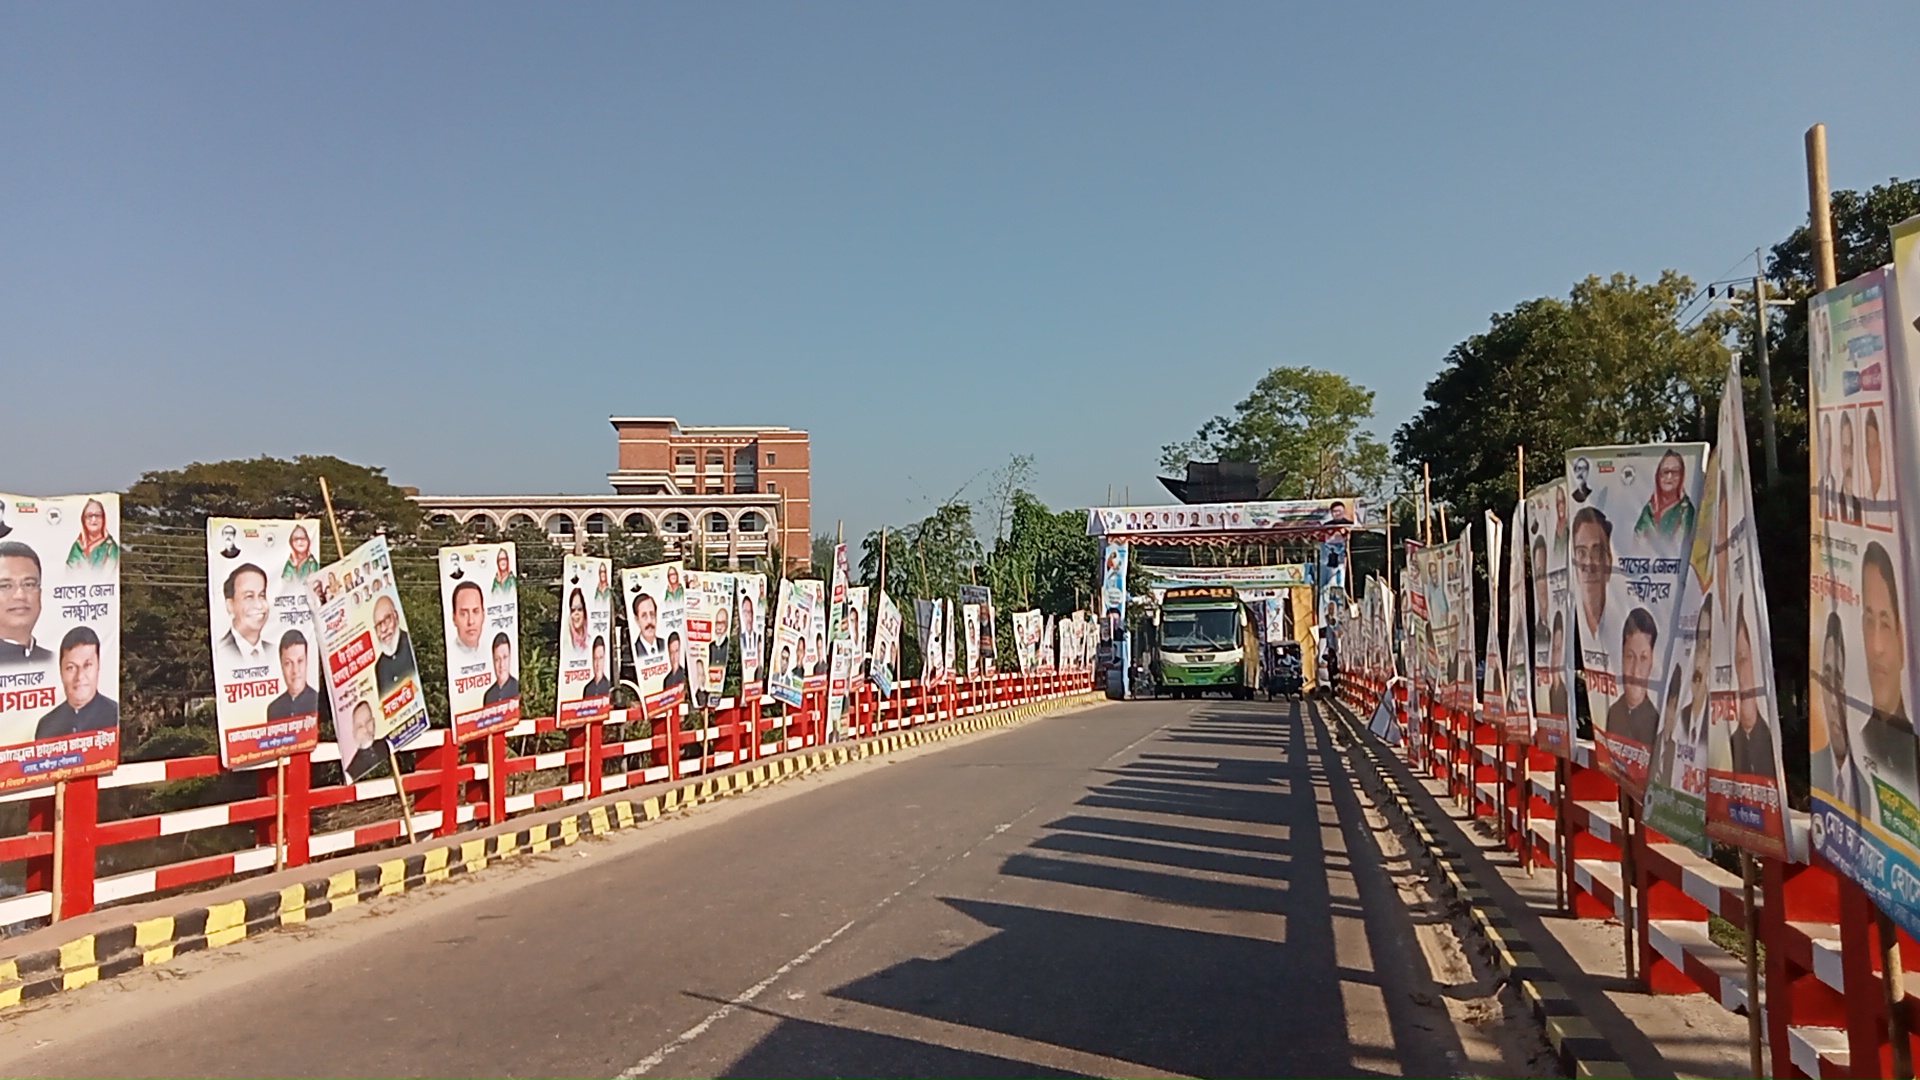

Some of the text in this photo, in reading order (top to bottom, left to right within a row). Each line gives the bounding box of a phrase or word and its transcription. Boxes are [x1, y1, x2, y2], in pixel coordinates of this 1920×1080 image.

[1653, 558, 1682, 575] জেলা
[53, 584, 115, 599] প্রাণের জেলা
[61, 600, 108, 621] লক্ষ্মীপুরে
[224, 678, 280, 703] স্বাগতম
[454, 672, 492, 694] স্বাগতম
